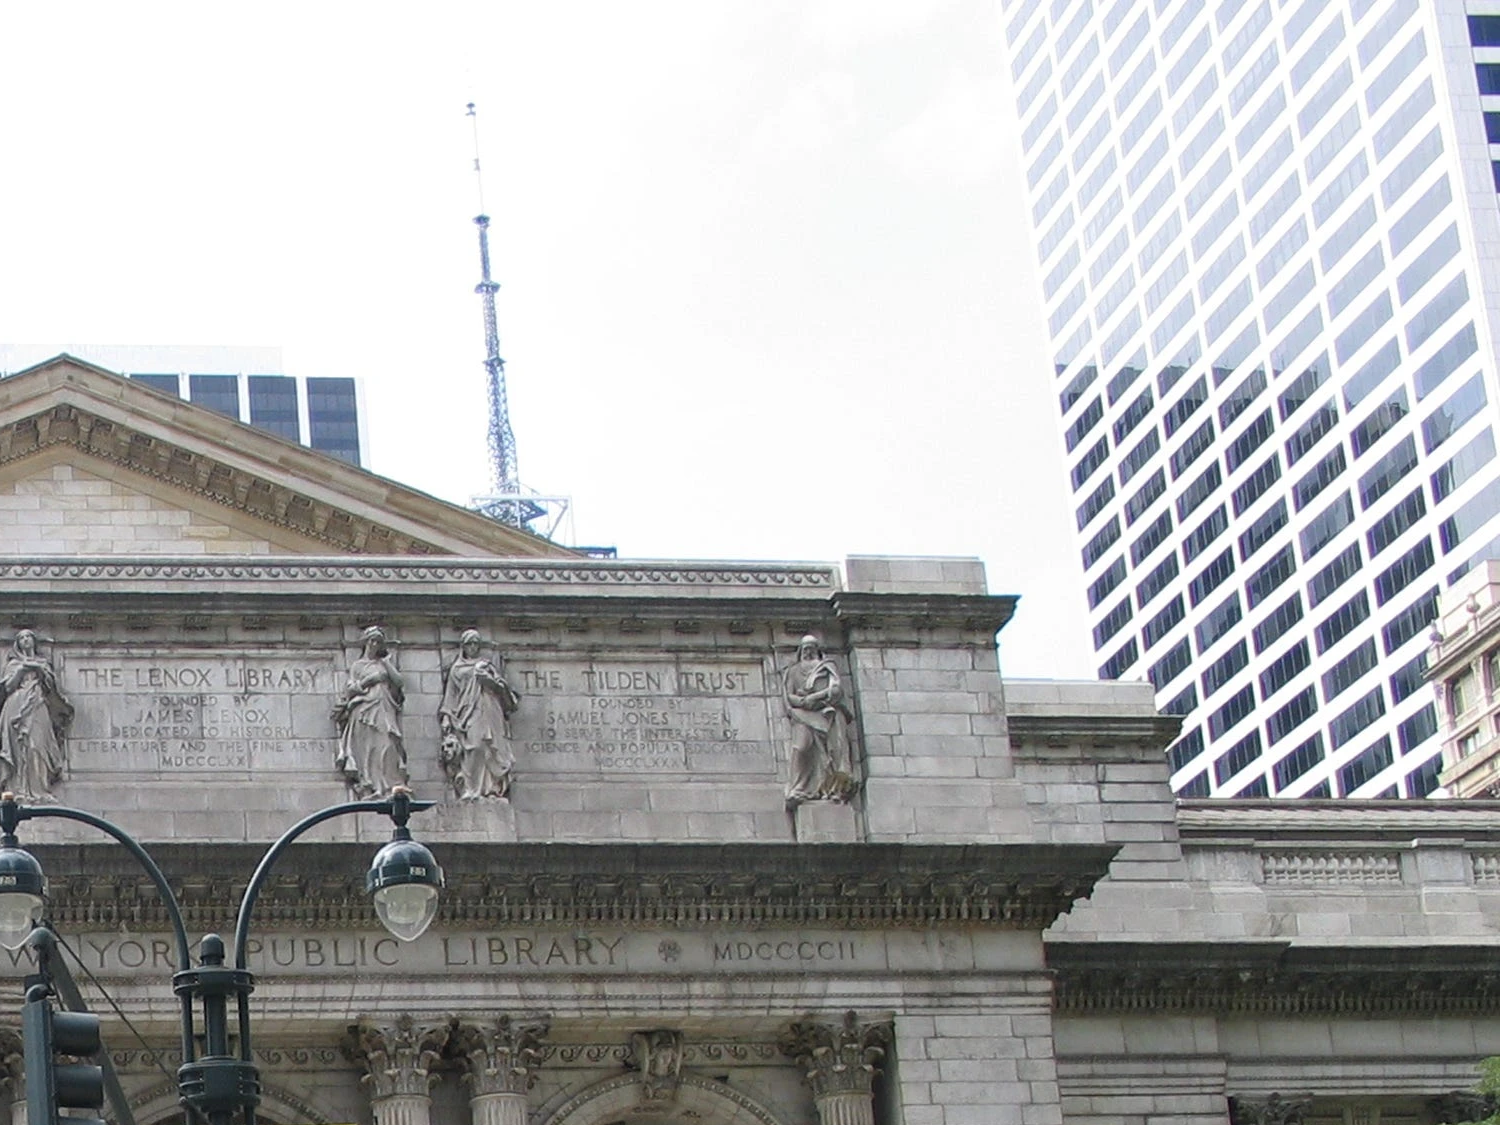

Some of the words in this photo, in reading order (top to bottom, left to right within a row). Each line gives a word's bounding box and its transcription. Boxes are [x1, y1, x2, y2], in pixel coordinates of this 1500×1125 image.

[78, 668, 123, 688] THE
[136, 668, 211, 688] LENOX
[225, 668, 321, 688] LIBRARY
[519, 670, 563, 689] THE
[582, 671, 660, 690] TILDEN
[679, 672, 749, 691] TRUST
[153, 695, 218, 707] FOUNDED
[234, 696, 251, 707] BY
[590, 698, 654, 709] FOUNDED
[135, 709, 194, 724] JAMES
[209, 709, 270, 724] LENOX
[547, 711, 610, 726] SAMUEL
[618, 711, 669, 726] JONES
[678, 712, 731, 726] TILDEN
[112, 726, 190, 738] DEDICATED
[202, 726, 220, 738] TO
[538, 728, 557, 740] TO
[723, 728, 739, 740] OF
[77, 741, 168, 753] LITERATURE
[180, 741, 206, 752] AND
[218, 741, 243, 753] THE
[252, 741, 284, 753] FINE
[292, 741, 326, 753] ARTS
[588, 741, 615, 753] AND
[161, 755, 246, 768] MDCCCLXX
[246, 937, 400, 967] PUBLIC
[442, 936, 624, 967] LIBRARY
[712, 940, 856, 961] MDCCCCII
